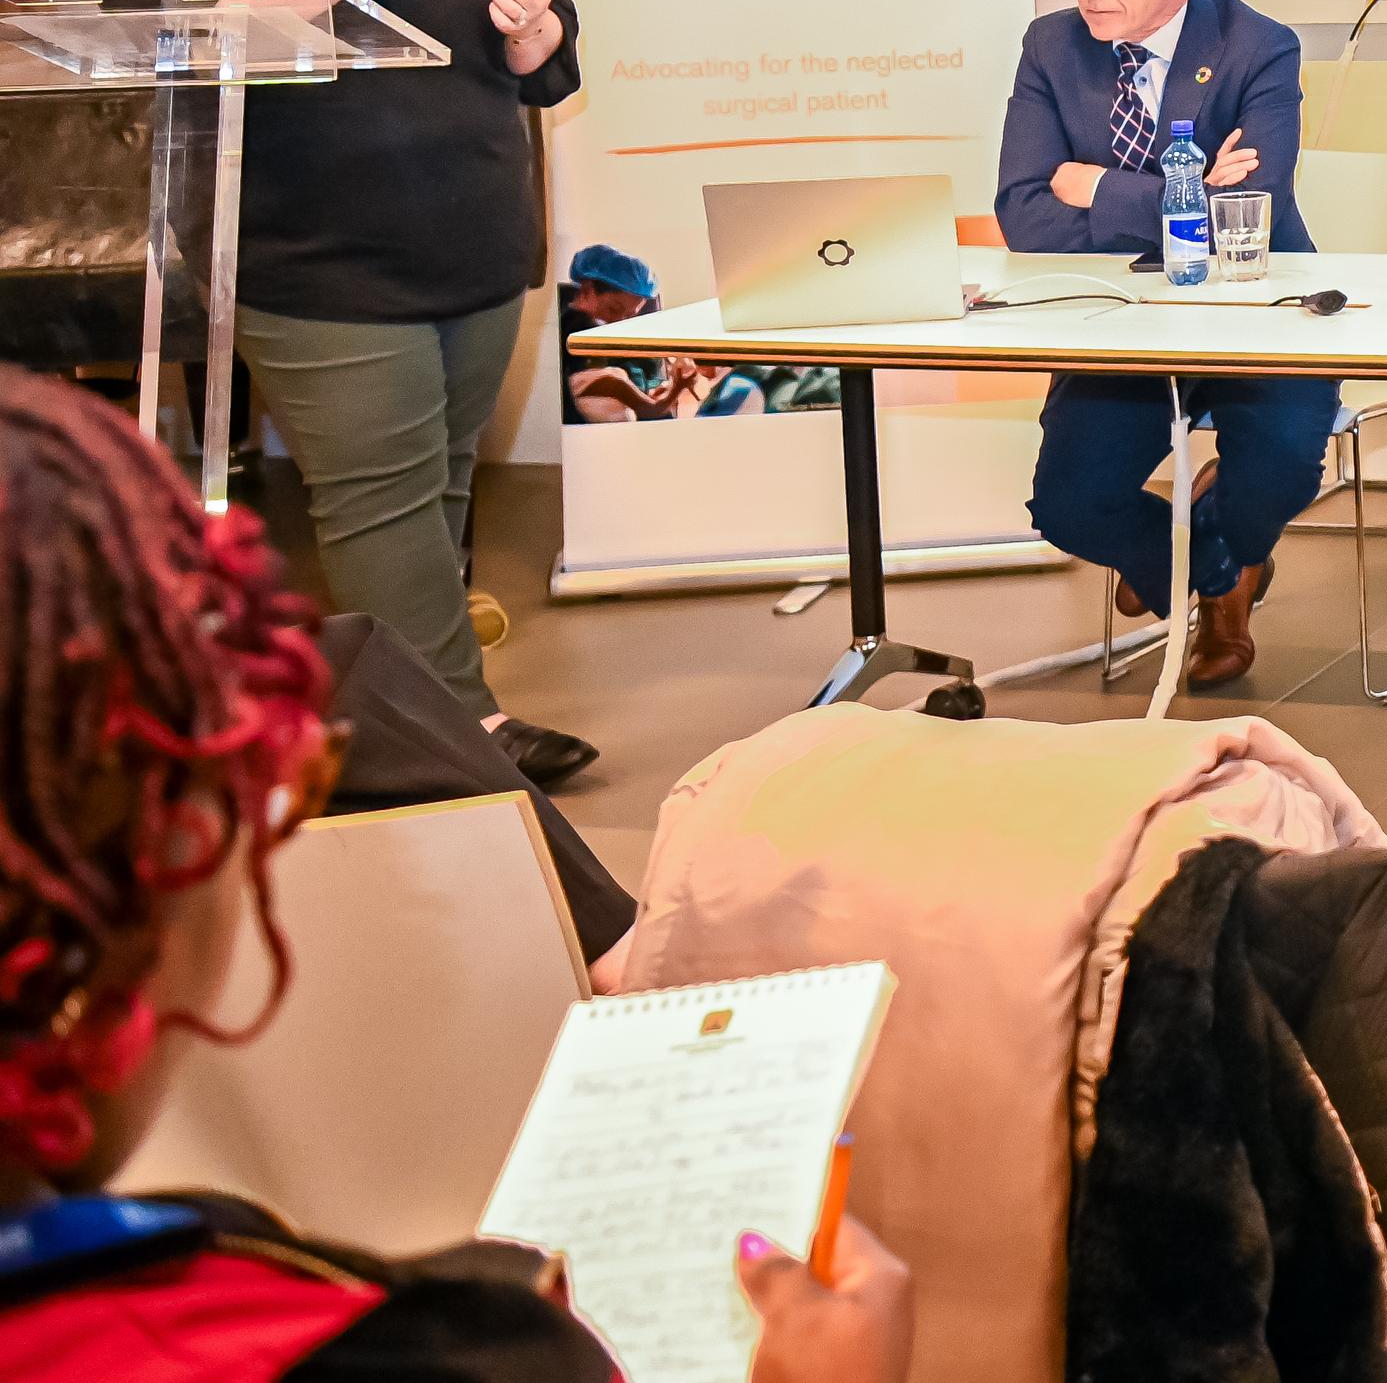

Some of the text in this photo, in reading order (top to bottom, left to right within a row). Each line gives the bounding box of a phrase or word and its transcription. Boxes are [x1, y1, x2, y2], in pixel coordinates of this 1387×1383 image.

[611, 47, 965, 82] Advocating for the neglected
[704, 87, 890, 121] surgical patient
